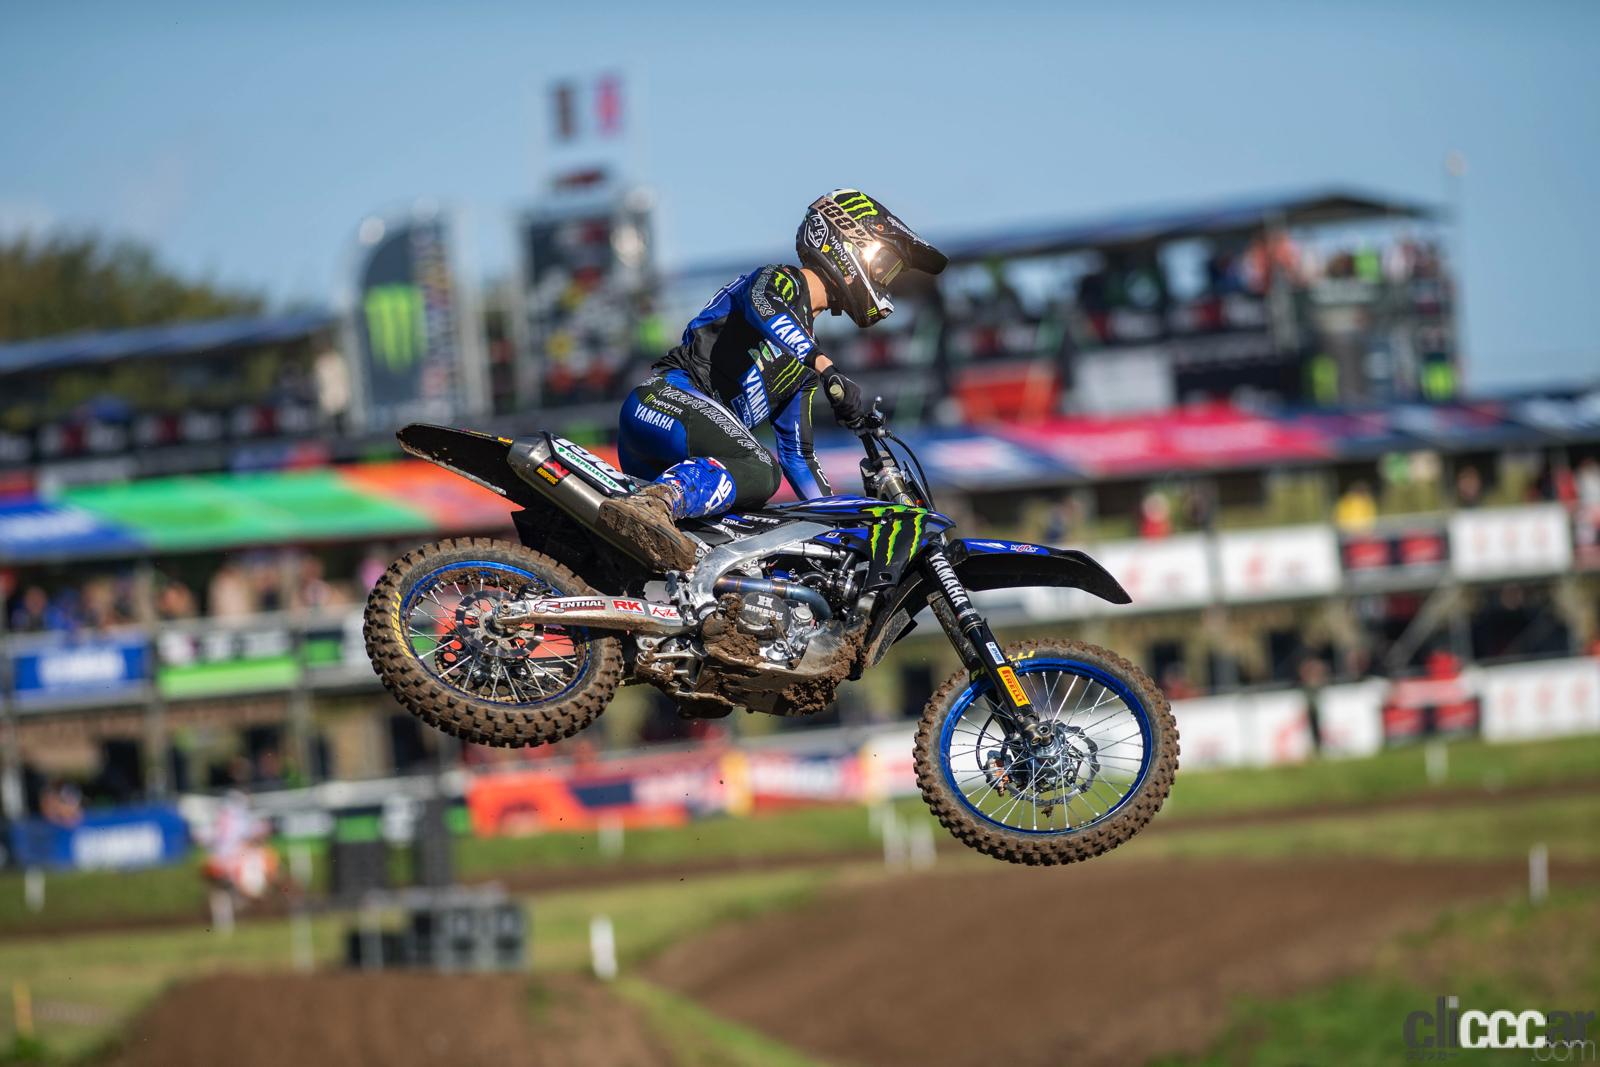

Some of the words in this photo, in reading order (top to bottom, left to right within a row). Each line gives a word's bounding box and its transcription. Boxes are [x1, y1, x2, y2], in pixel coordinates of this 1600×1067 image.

[817, 199, 873, 248] 100%
[830, 236, 858, 279] MONSTER
[770, 315, 811, 362] YAMA
[652, 398, 684, 415] MONSTER
[745, 368, 770, 424] YAMAH
[634, 403, 675, 431] YAMAHA
[929, 552, 969, 607] YAMAHA
[534, 600, 606, 615] RENTHAL
[612, 600, 644, 611] RK
[1001, 668, 1027, 703] PIRELLI
